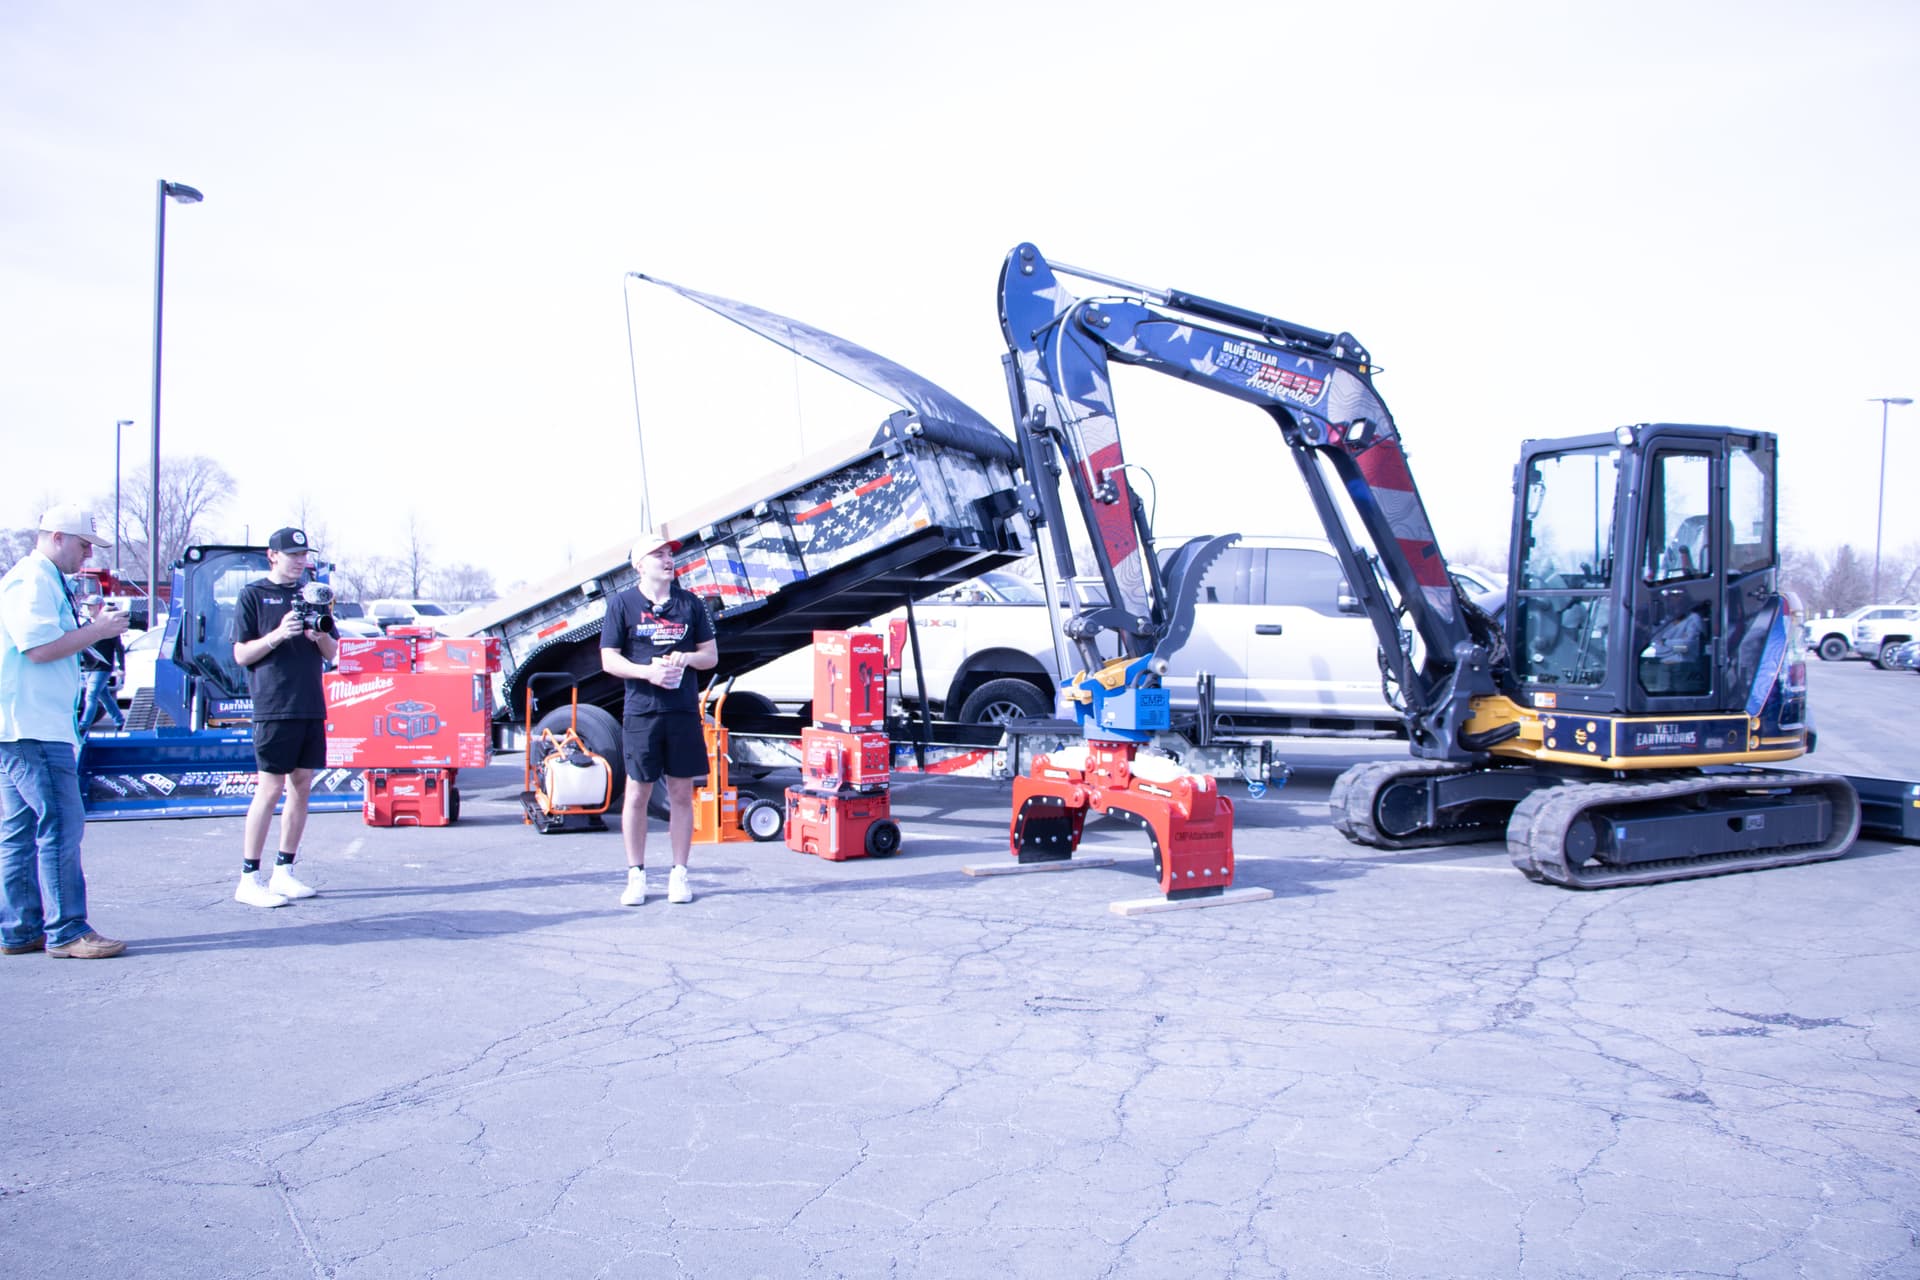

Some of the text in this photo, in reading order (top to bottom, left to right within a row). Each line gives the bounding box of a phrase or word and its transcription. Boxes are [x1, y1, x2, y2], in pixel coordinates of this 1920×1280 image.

[1222, 341, 1278, 367] BLUE COLLAR
[1215, 351, 1324, 395] BUSINESS
[327, 676, 395, 702] Milwaukee
[1636, 731, 1697, 746] EARTHWORKS
[1656, 724, 1680, 733] YETI
